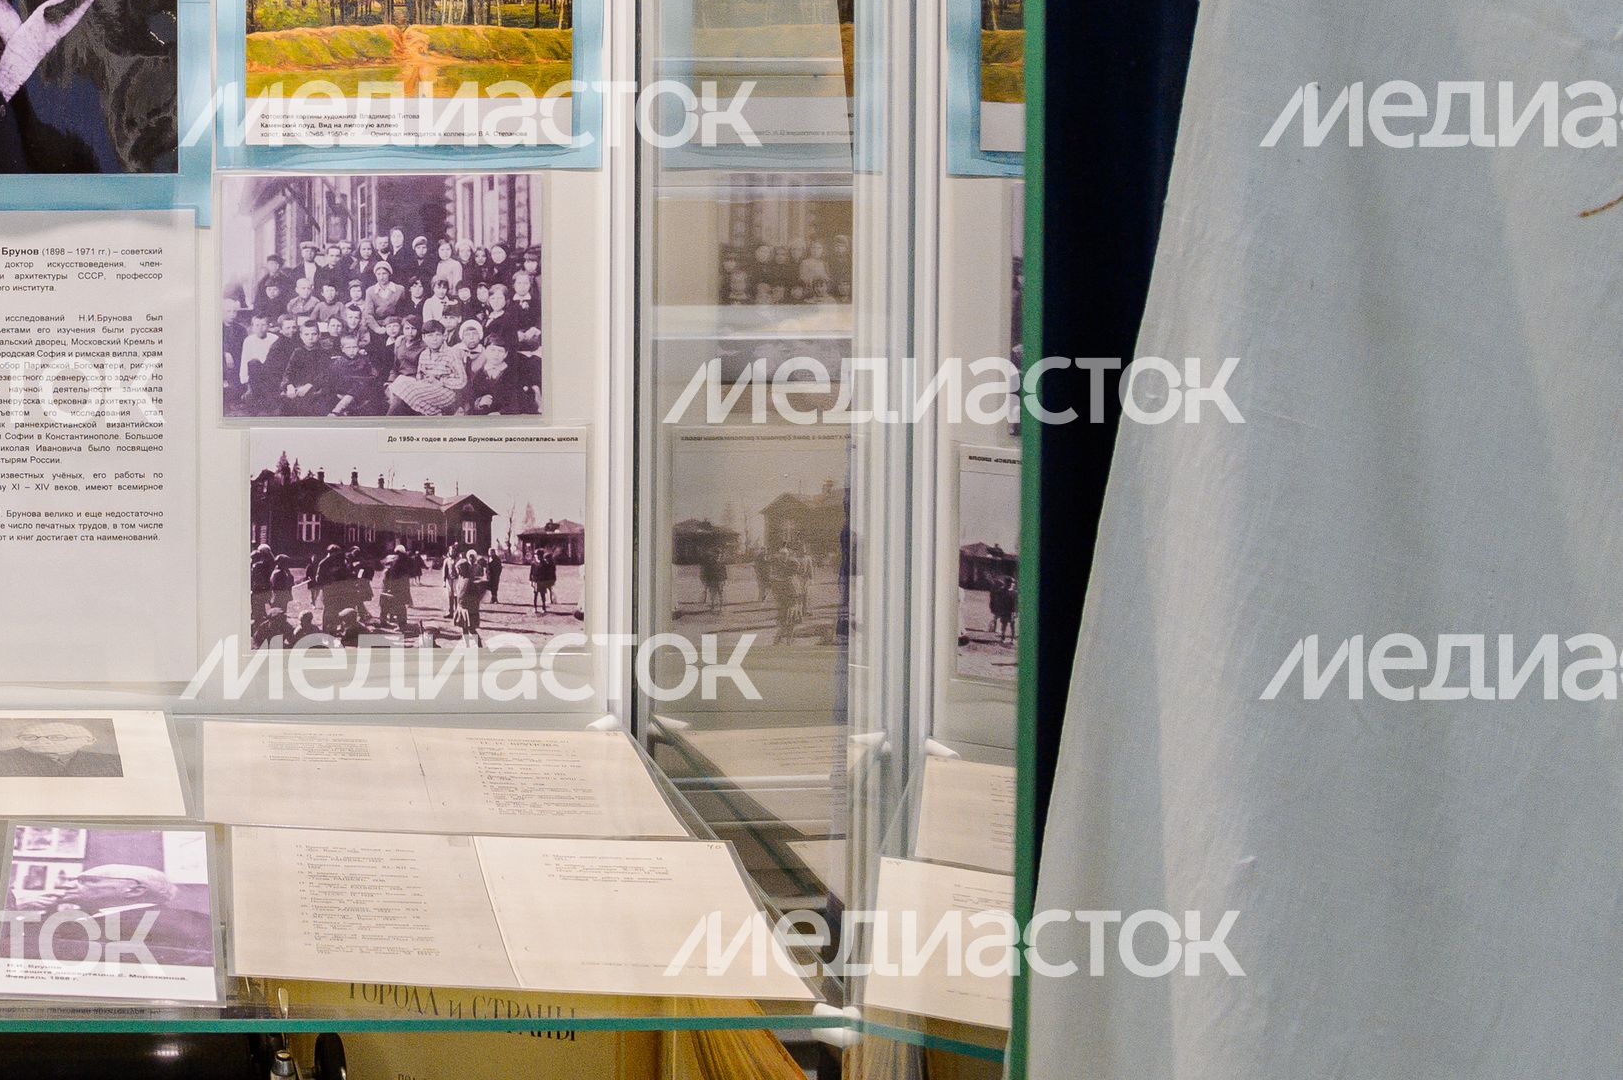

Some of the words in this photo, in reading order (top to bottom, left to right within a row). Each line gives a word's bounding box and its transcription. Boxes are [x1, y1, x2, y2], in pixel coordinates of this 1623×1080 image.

[1, 246, 39, 257] Брунов
[42, 247, 65, 256] (1898
[76, 247, 94, 255] 1971
[120, 247, 162, 255] советский
[4, 261, 34, 269] доктор
[14, 273, 67, 281] архитектуры
[116, 272, 162, 280] профессор
[6, 509, 41, 519] Брунова
